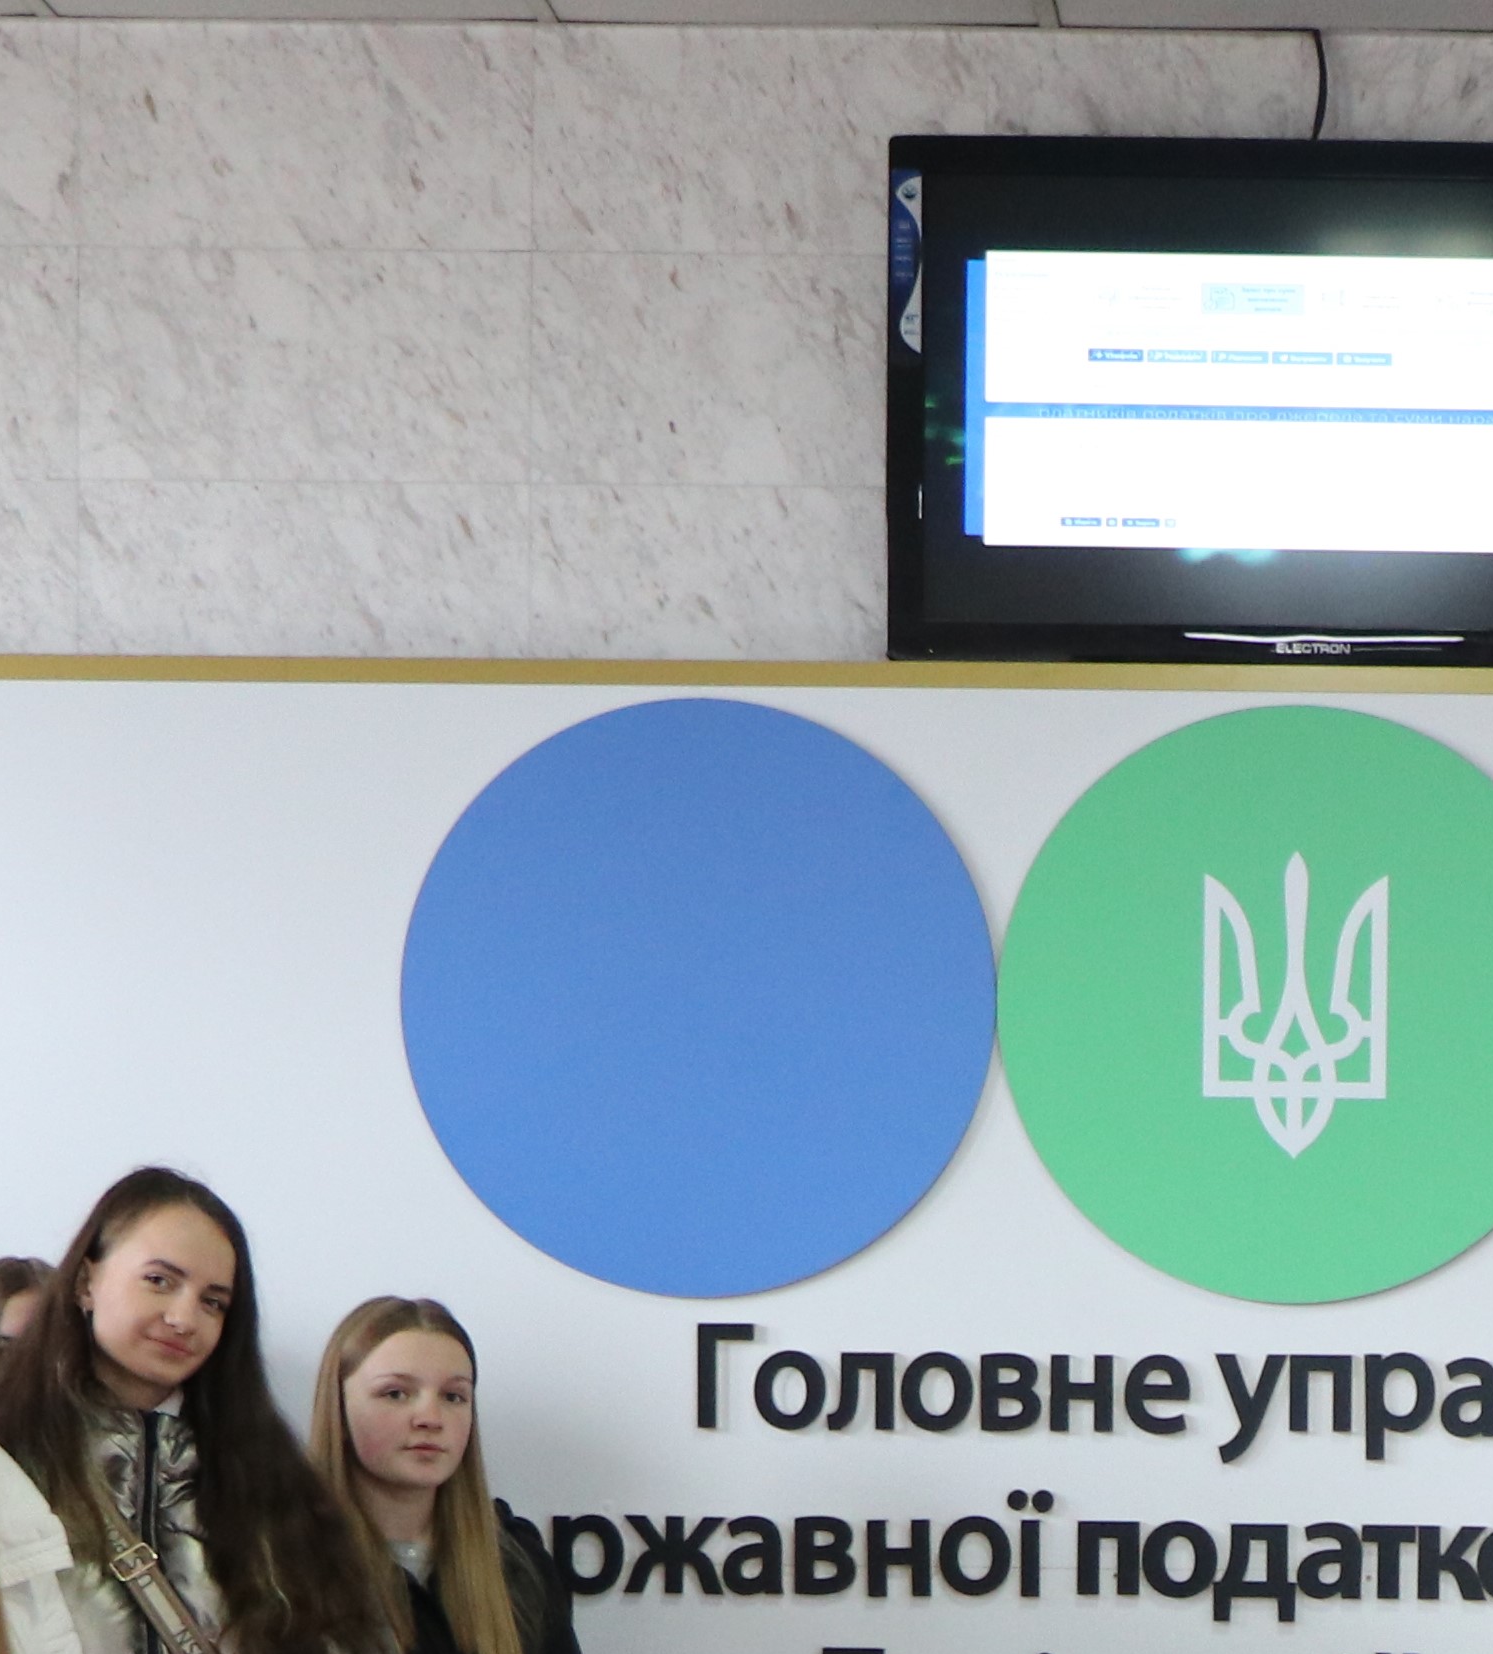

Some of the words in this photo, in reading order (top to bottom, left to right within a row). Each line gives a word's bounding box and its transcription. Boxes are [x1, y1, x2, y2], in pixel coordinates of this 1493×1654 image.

[1275, 643, 1351, 654] ELECTRON
[697, 1322, 1192, 1435] Головне
[511, 1489, 1055, 1598] ржавної
